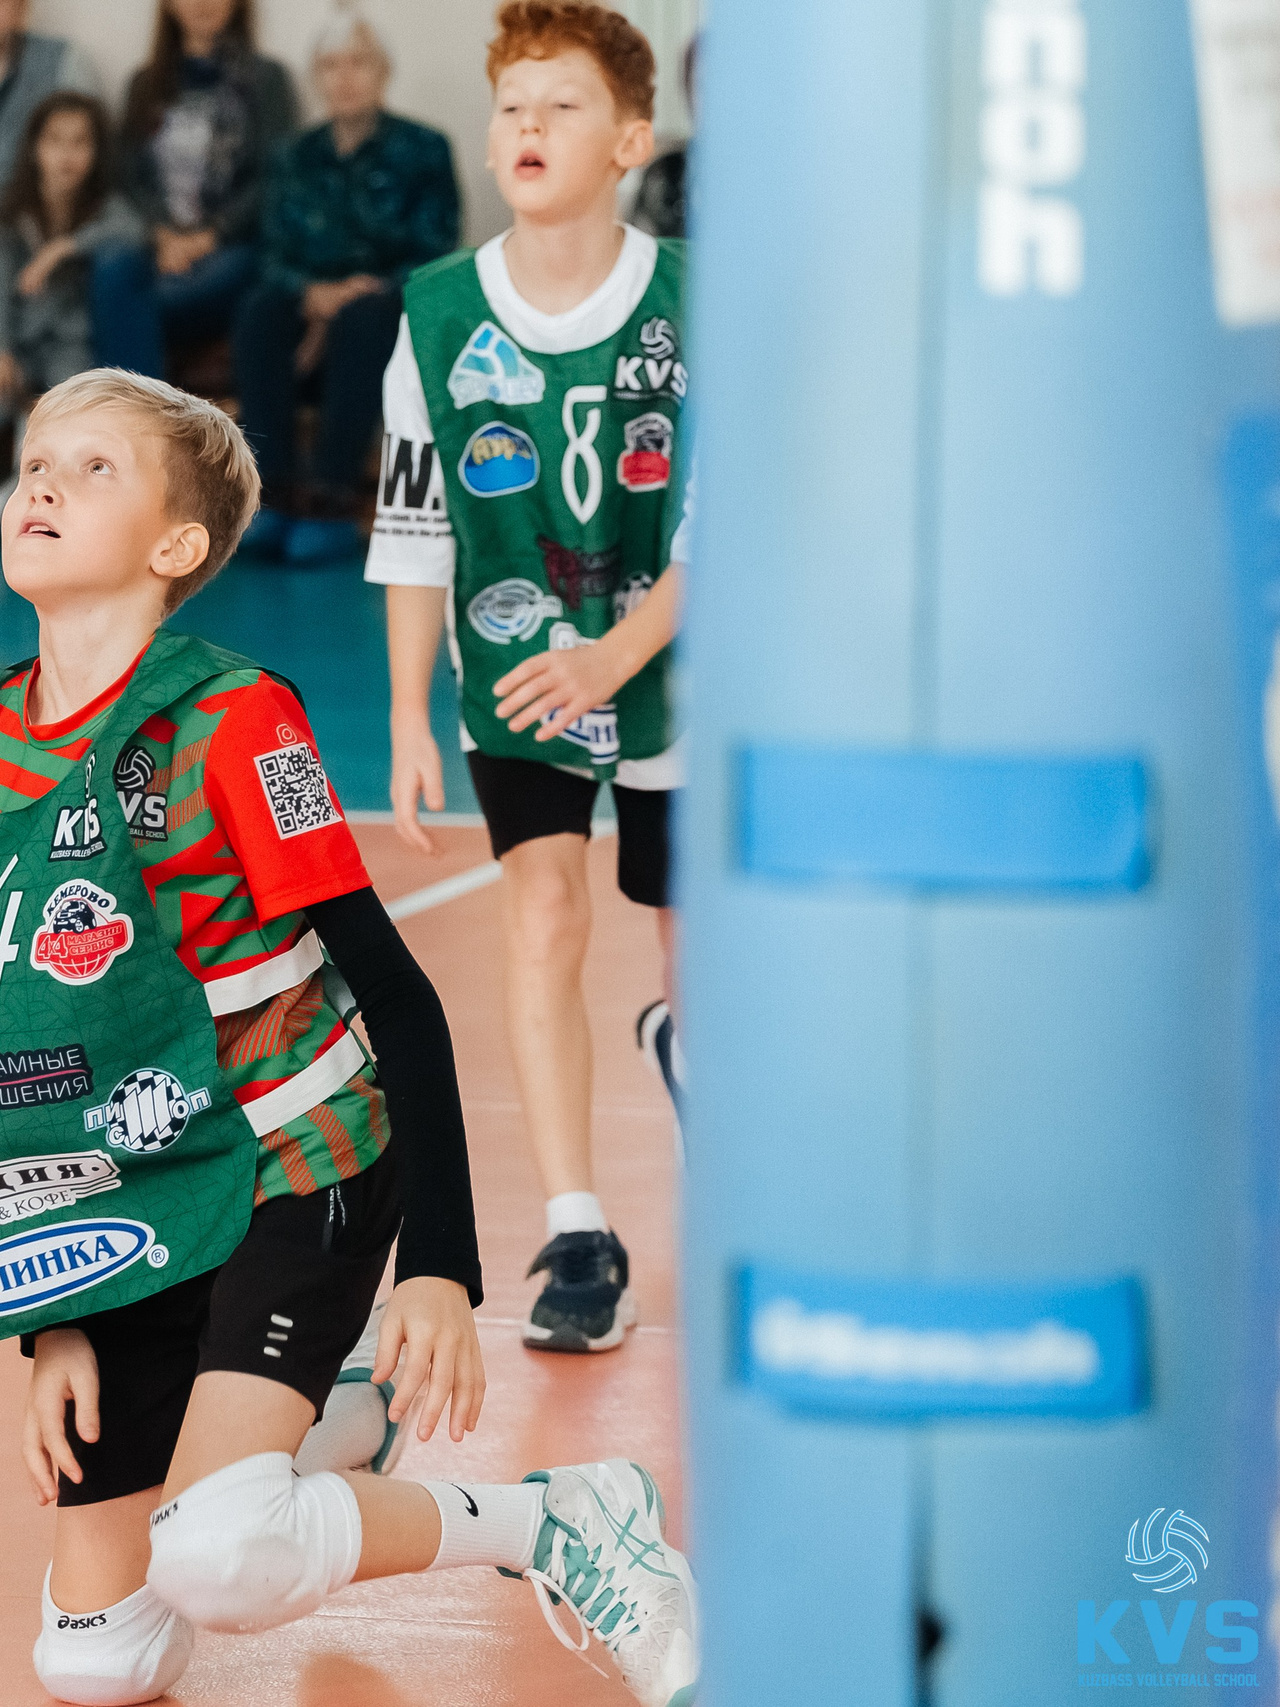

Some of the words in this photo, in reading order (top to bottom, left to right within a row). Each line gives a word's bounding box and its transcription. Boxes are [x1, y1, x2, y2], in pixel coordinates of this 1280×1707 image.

[615, 356, 688, 397] KVS
[561, 384, 607, 525] 8
[117, 791, 167, 828] VS
[46, 884, 111, 918] КЕМЕРОВО
[66, 924, 123, 946] МАГАЗИН
[68, 936, 115, 956] СЕРВИС
[13, 1188, 73, 1217] КОФЕ
